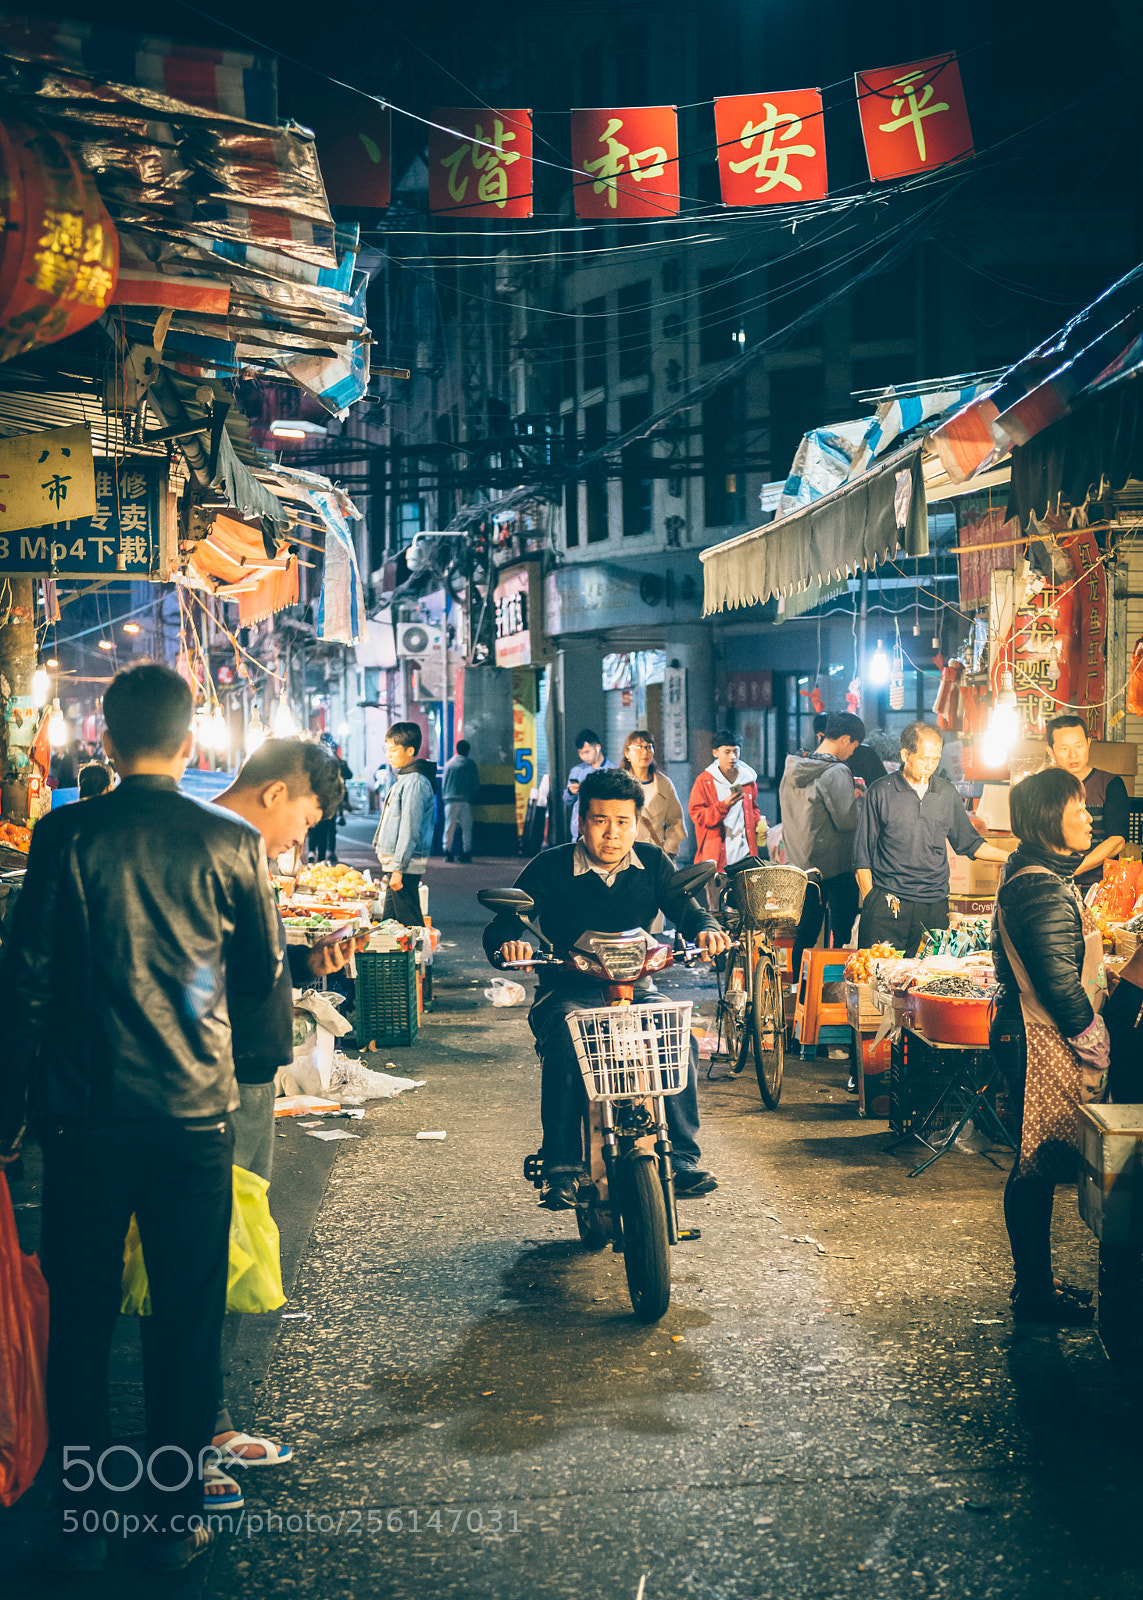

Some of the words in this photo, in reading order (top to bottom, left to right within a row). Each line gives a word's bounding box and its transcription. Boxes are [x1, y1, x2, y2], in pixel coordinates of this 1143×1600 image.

[728, 102, 816, 195] 安
[878, 69, 950, 163] 平
[440, 118, 521, 210] 谐
[582, 118, 666, 209] 和
[1016, 587, 1059, 740] 红龙鹦鹉
[1078, 542, 1101, 741] 红龙鱼缸厂价
[515, 748, 533, 785] 5
